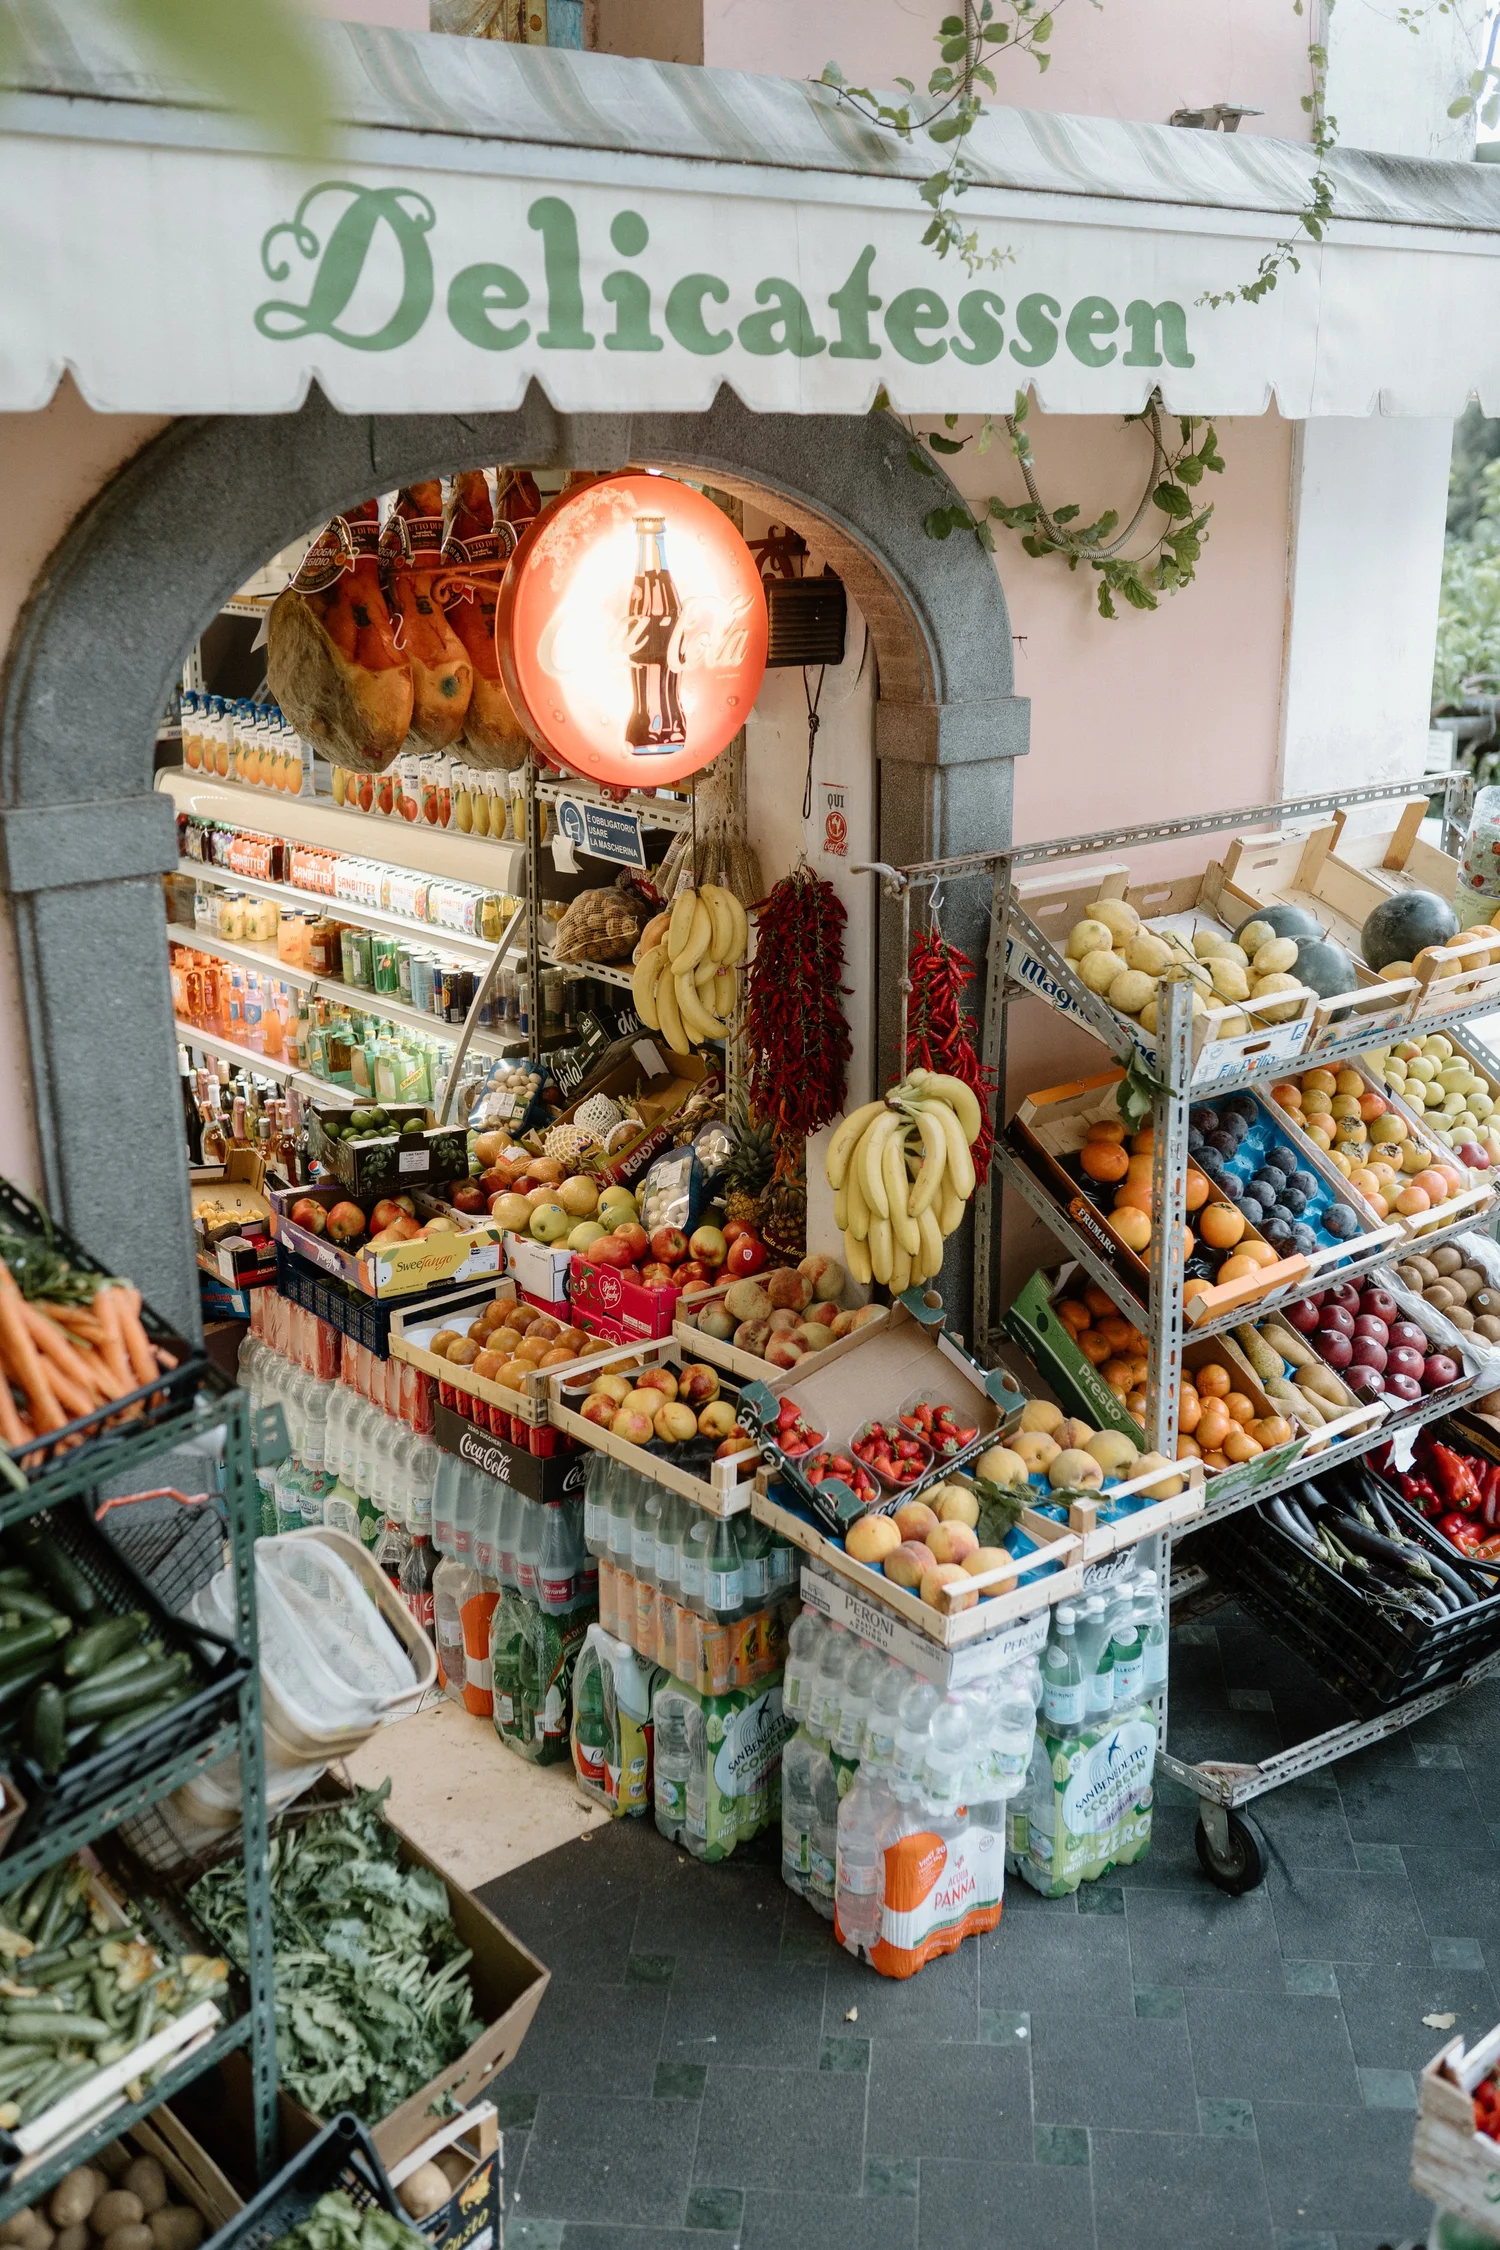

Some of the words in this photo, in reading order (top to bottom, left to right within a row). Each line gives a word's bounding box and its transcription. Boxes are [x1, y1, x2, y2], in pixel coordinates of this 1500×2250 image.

[254, 180, 1196, 369] Delicatessen
[827, 793, 844, 809] QUI
[589, 826, 608, 838] USARE
[592, 816, 636, 834] OBBLIGATORIO
[590, 838, 597, 846] LA
[599, 840, 638, 858] MASCHERINA
[230, 853, 266, 871] SANBITTER
[292, 866, 332, 886] SANBITTER
[338, 876, 376, 894] SANBITTER
[620, 1141, 656, 1178] READY
[653, 1131, 667, 1146] TO
[1078, 1208, 1116, 1254] FRUMARC
[396, 1254, 453, 1273] SweeTango
[602, 1282, 617, 1293] Pink
[604, 1291, 618, 1301] Lady
[1078, 1363, 1122, 1421] Presto
[467, 1424, 480, 1436] ZERO
[479, 1431, 502, 1447] ZUCCHERI
[938, 1445, 984, 1479] VERONA
[844, 1593, 895, 1638] PERONI
[855, 1617, 883, 1636] NASTRO
[850, 1620, 888, 1648] AZZURRO
[1003, 1626, 1046, 1655] PERONI
[736, 1723, 793, 1781] ECOGREEN
[1093, 1744, 1149, 1794] BENEDETTO
[1083, 1760, 1147, 1819] ECOGREEN
[1098, 1814, 1151, 1860] ZERO
[947, 1869, 969, 1888] ACQUA
[933, 1876, 976, 1911] PANNA
